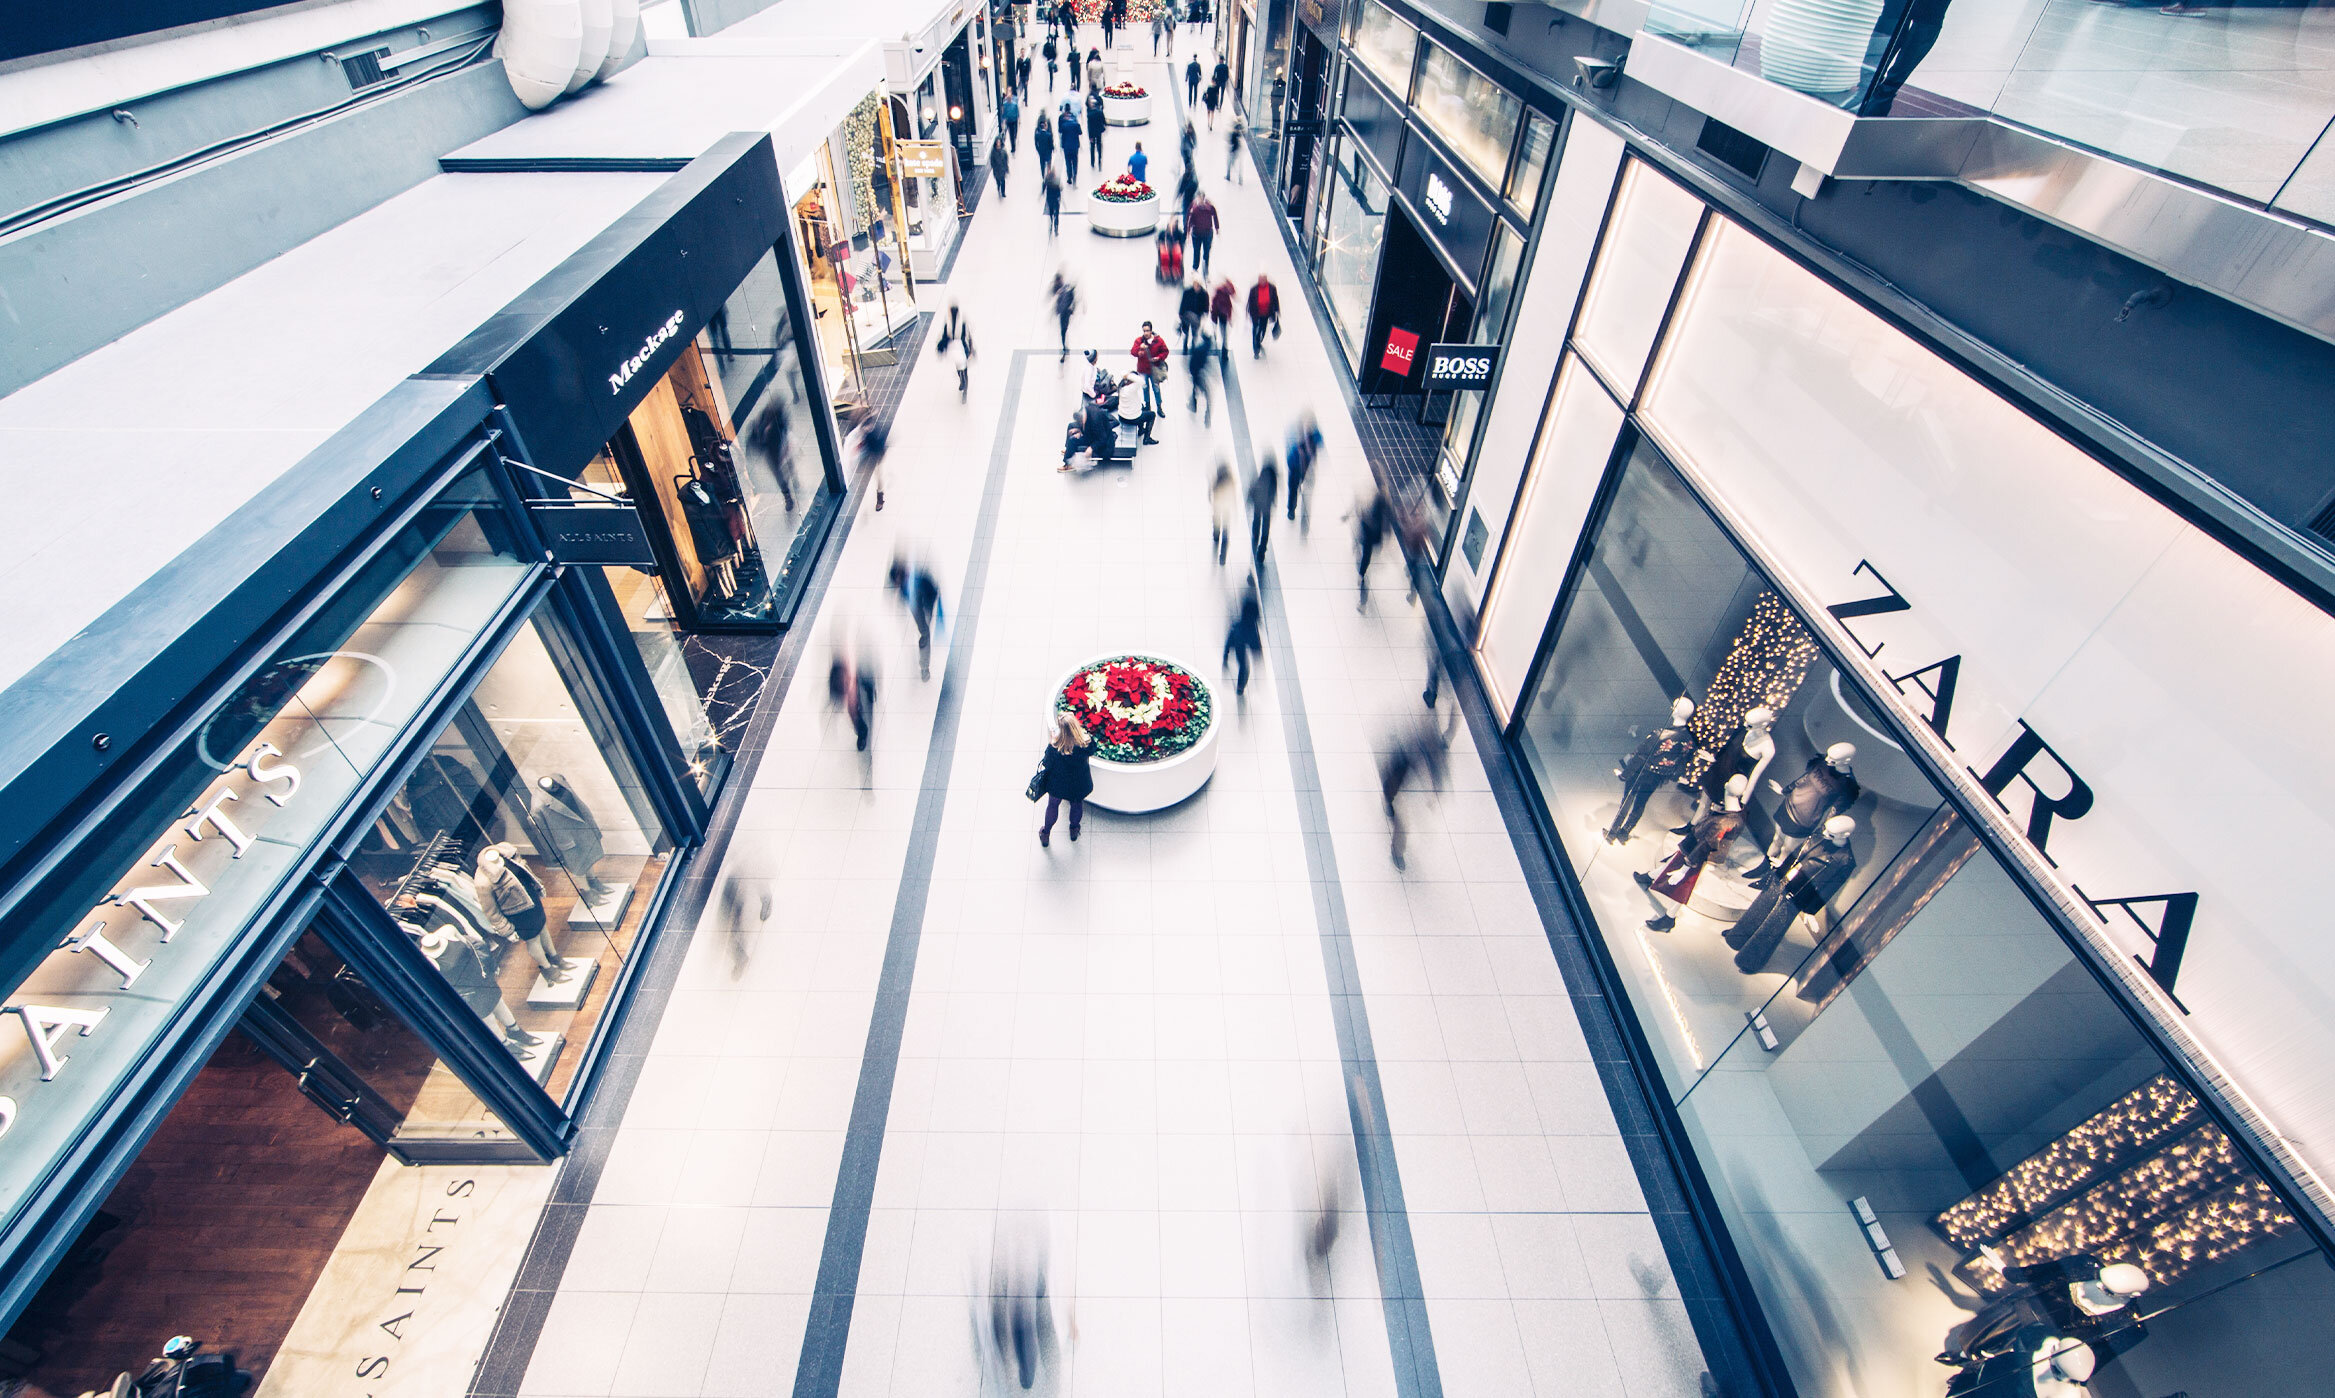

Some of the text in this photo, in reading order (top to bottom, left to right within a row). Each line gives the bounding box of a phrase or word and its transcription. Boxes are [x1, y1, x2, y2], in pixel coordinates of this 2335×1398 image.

[608, 309, 684, 396] Mackage
[1386, 343, 1413, 361] SALE
[1432, 356, 1490, 374] BOSS
[1826, 559, 2199, 1016] ZARA
[356, 1179, 475, 1398] SAINTS
